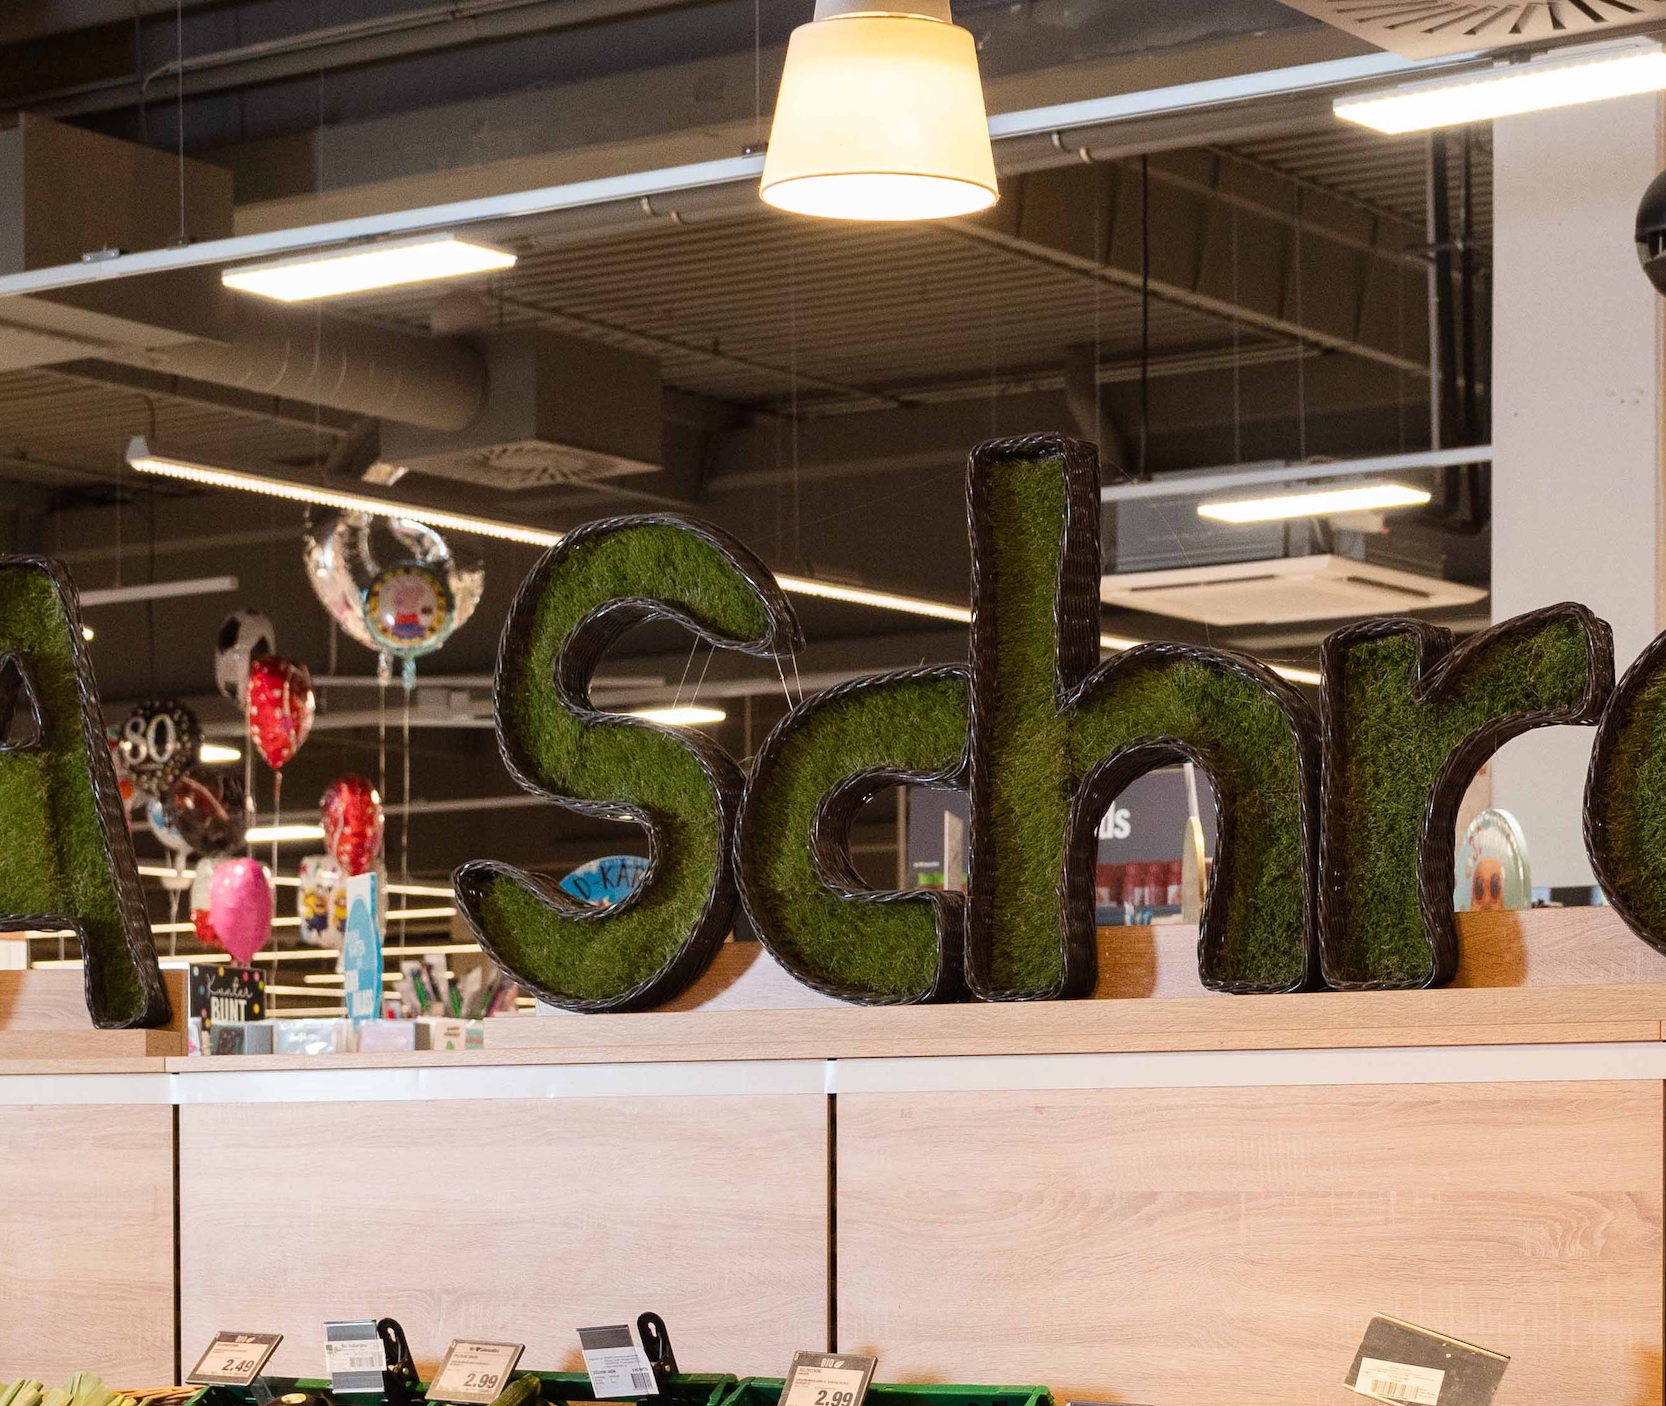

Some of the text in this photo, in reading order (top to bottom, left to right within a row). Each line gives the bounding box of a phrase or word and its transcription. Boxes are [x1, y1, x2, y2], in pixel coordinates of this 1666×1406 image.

[121, 713, 177, 765] 80
[210, 996, 247, 1022] BUNT
[221, 1359, 255, 1373] 2.49
[820, 1358, 834, 1368] BIO
[463, 1372, 499, 1389] 2.99
